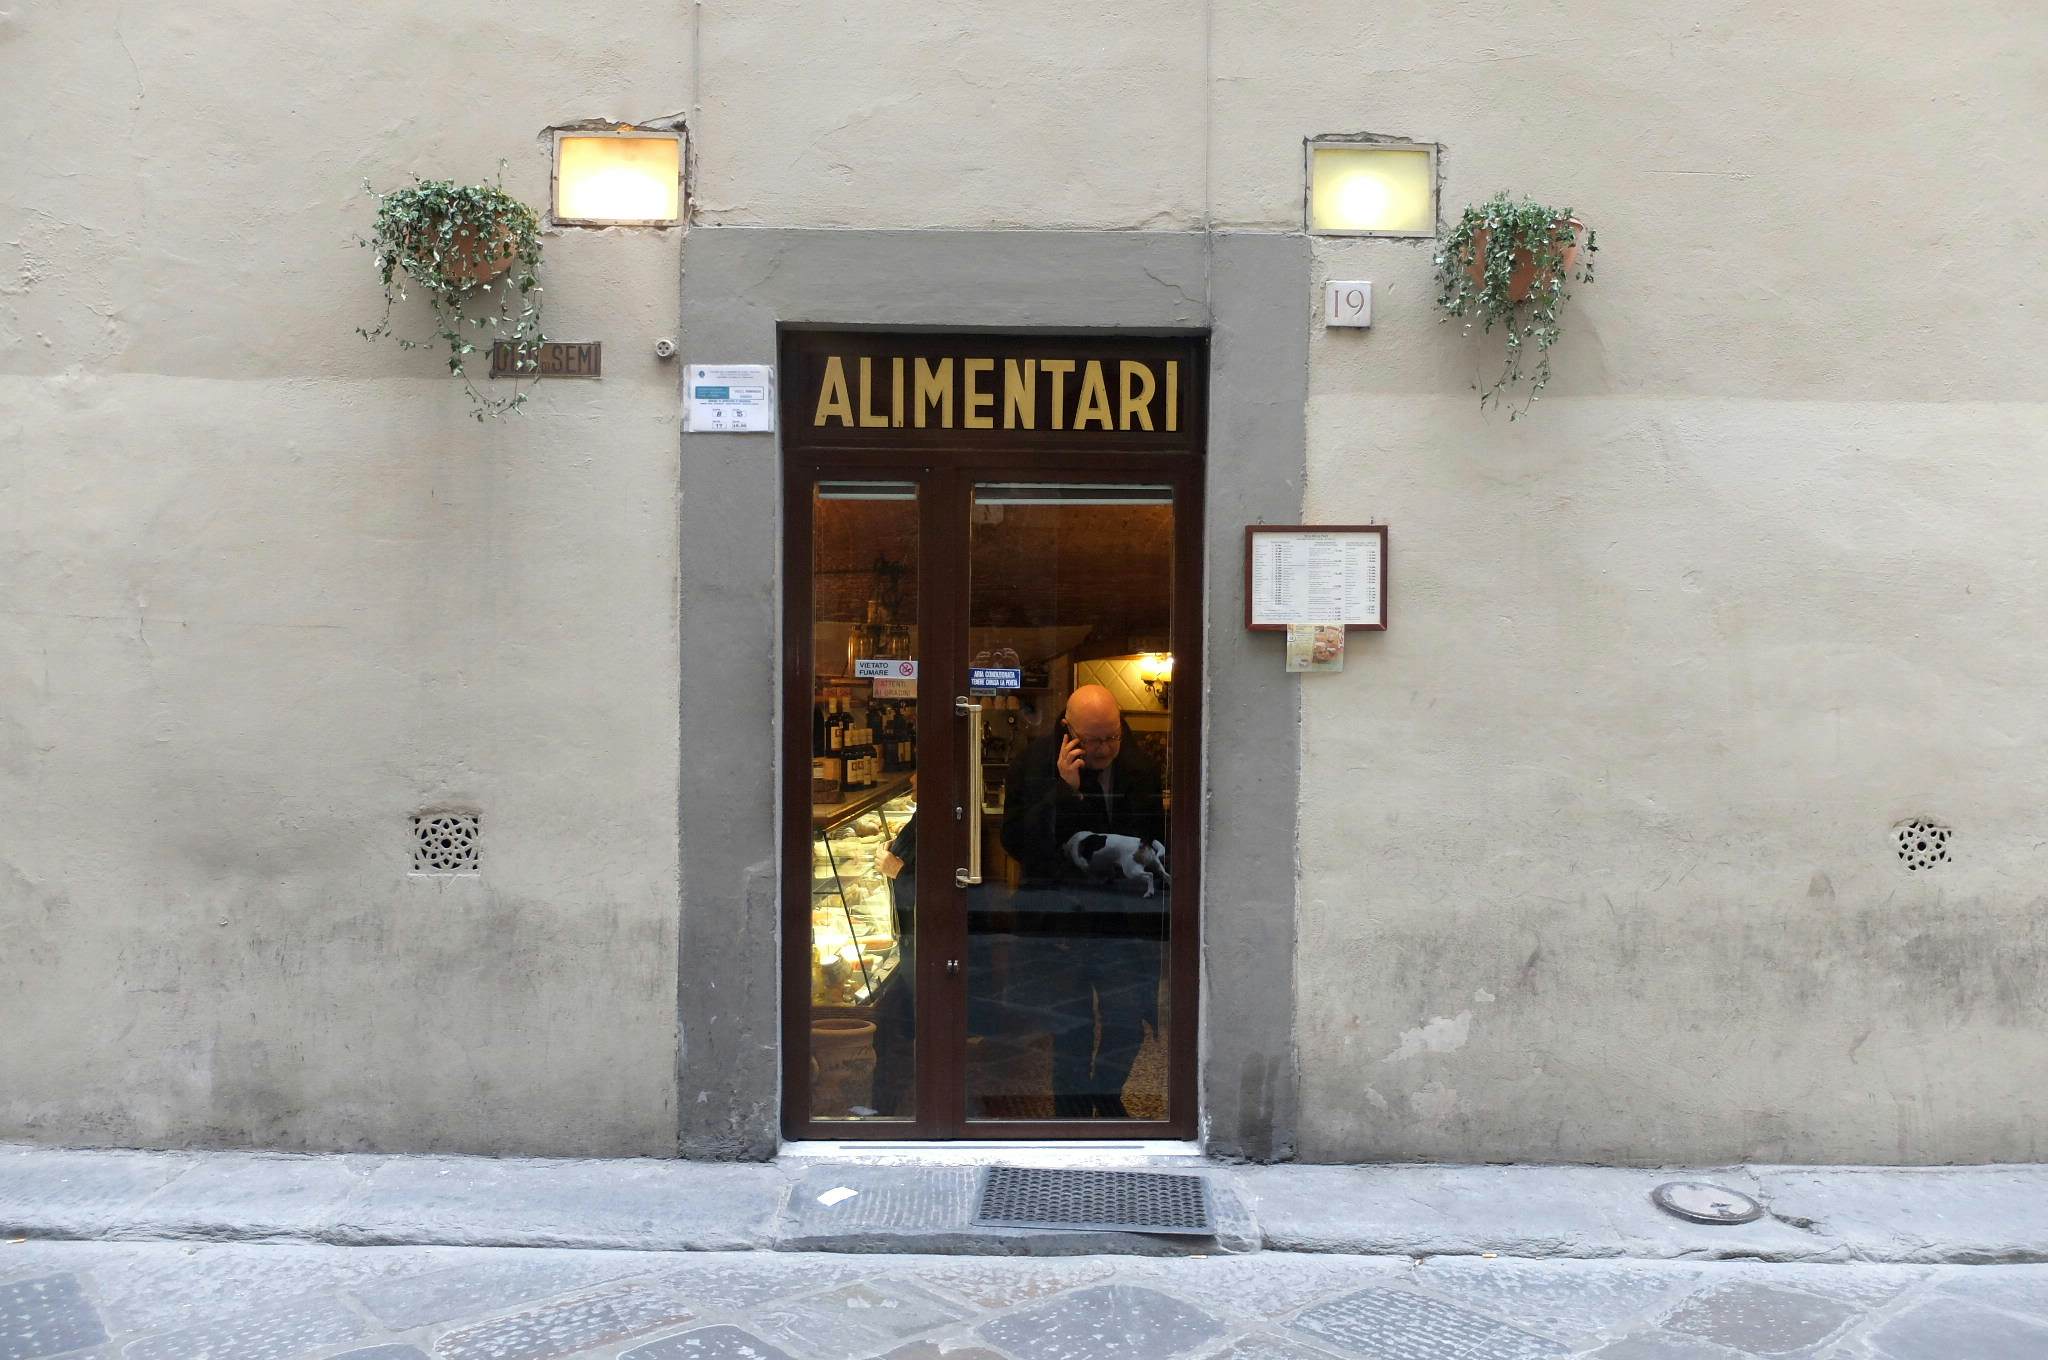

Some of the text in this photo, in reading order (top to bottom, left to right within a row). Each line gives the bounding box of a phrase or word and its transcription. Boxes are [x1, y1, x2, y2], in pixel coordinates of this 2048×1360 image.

[1334, 289, 1365, 318] 19
[552, 344, 598, 374] SEMI
[813, 355, 1179, 432] ALIMENTARI
